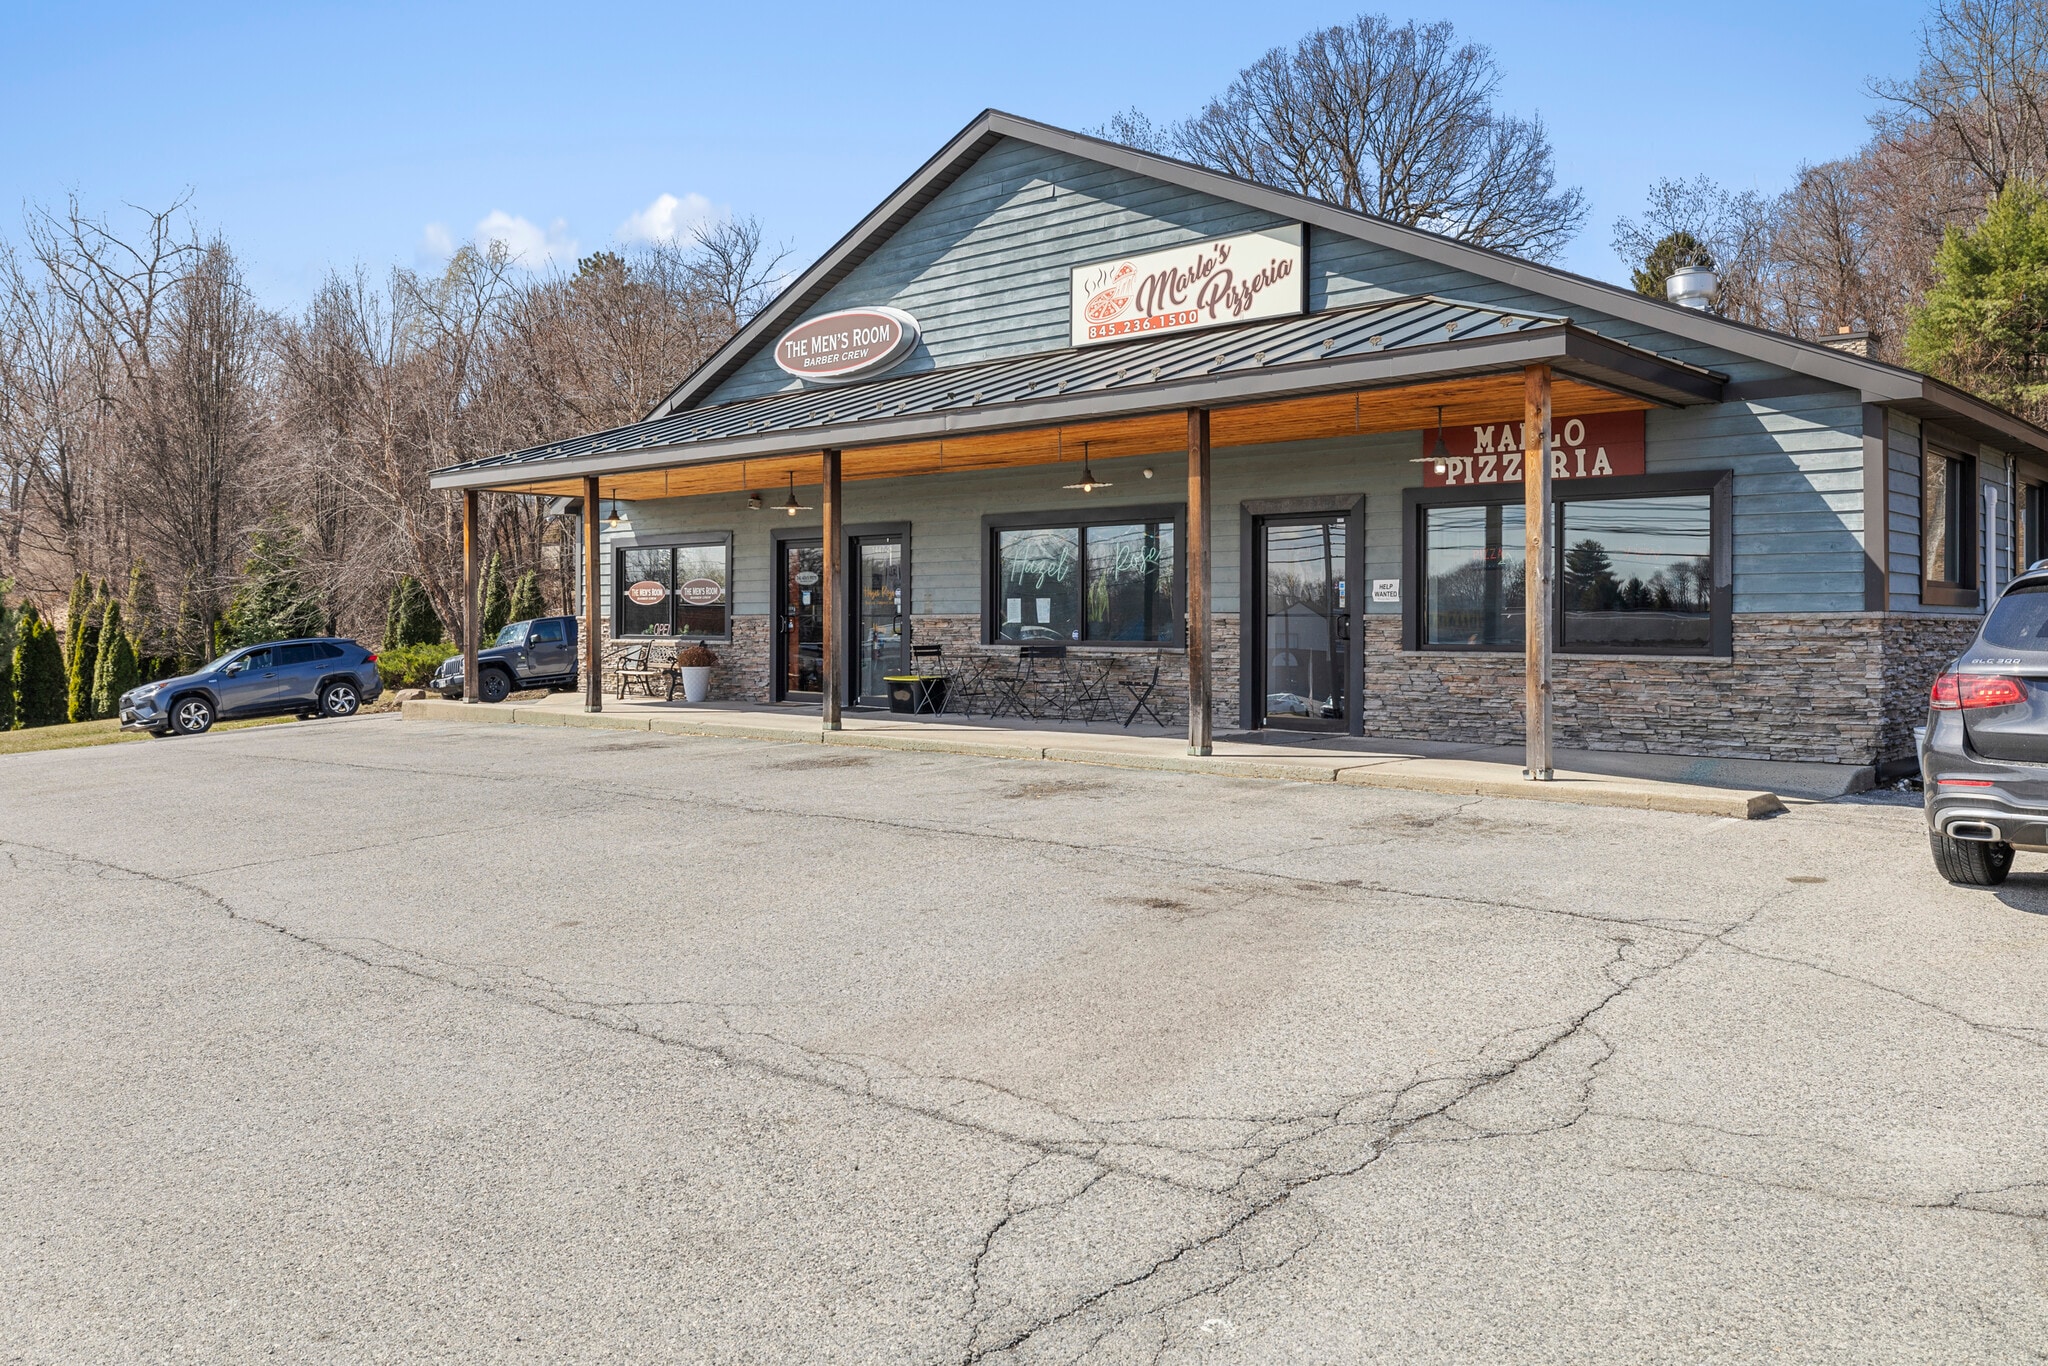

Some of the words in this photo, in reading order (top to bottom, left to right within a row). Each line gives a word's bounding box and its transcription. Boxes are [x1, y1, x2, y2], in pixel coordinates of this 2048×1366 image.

[1135, 243, 1232, 318] Marlo's
[1197, 259, 1293, 319] Pizzeria
[785, 339, 808, 359] THE
[811, 332, 849, 355] MEN'S
[853, 324, 890, 347] ROOM
[1089, 311, 1197, 339] 845.236.1500
[803, 354, 839, 367] BARBER
[841, 348, 869, 361] CREW
[1473, 418, 1585, 454] MAO
[1445, 447, 1613, 485] PIZZRIA
[1010, 543, 1069, 590] Hazel
[1114, 542, 1161, 582] Rose
[631, 588, 639, 597] THE
[651, 588, 663, 596] ROOM
[684, 587, 692, 596] THE
[692, 587, 705, 596] MEN'S
[705, 586, 718, 595] ROOM
